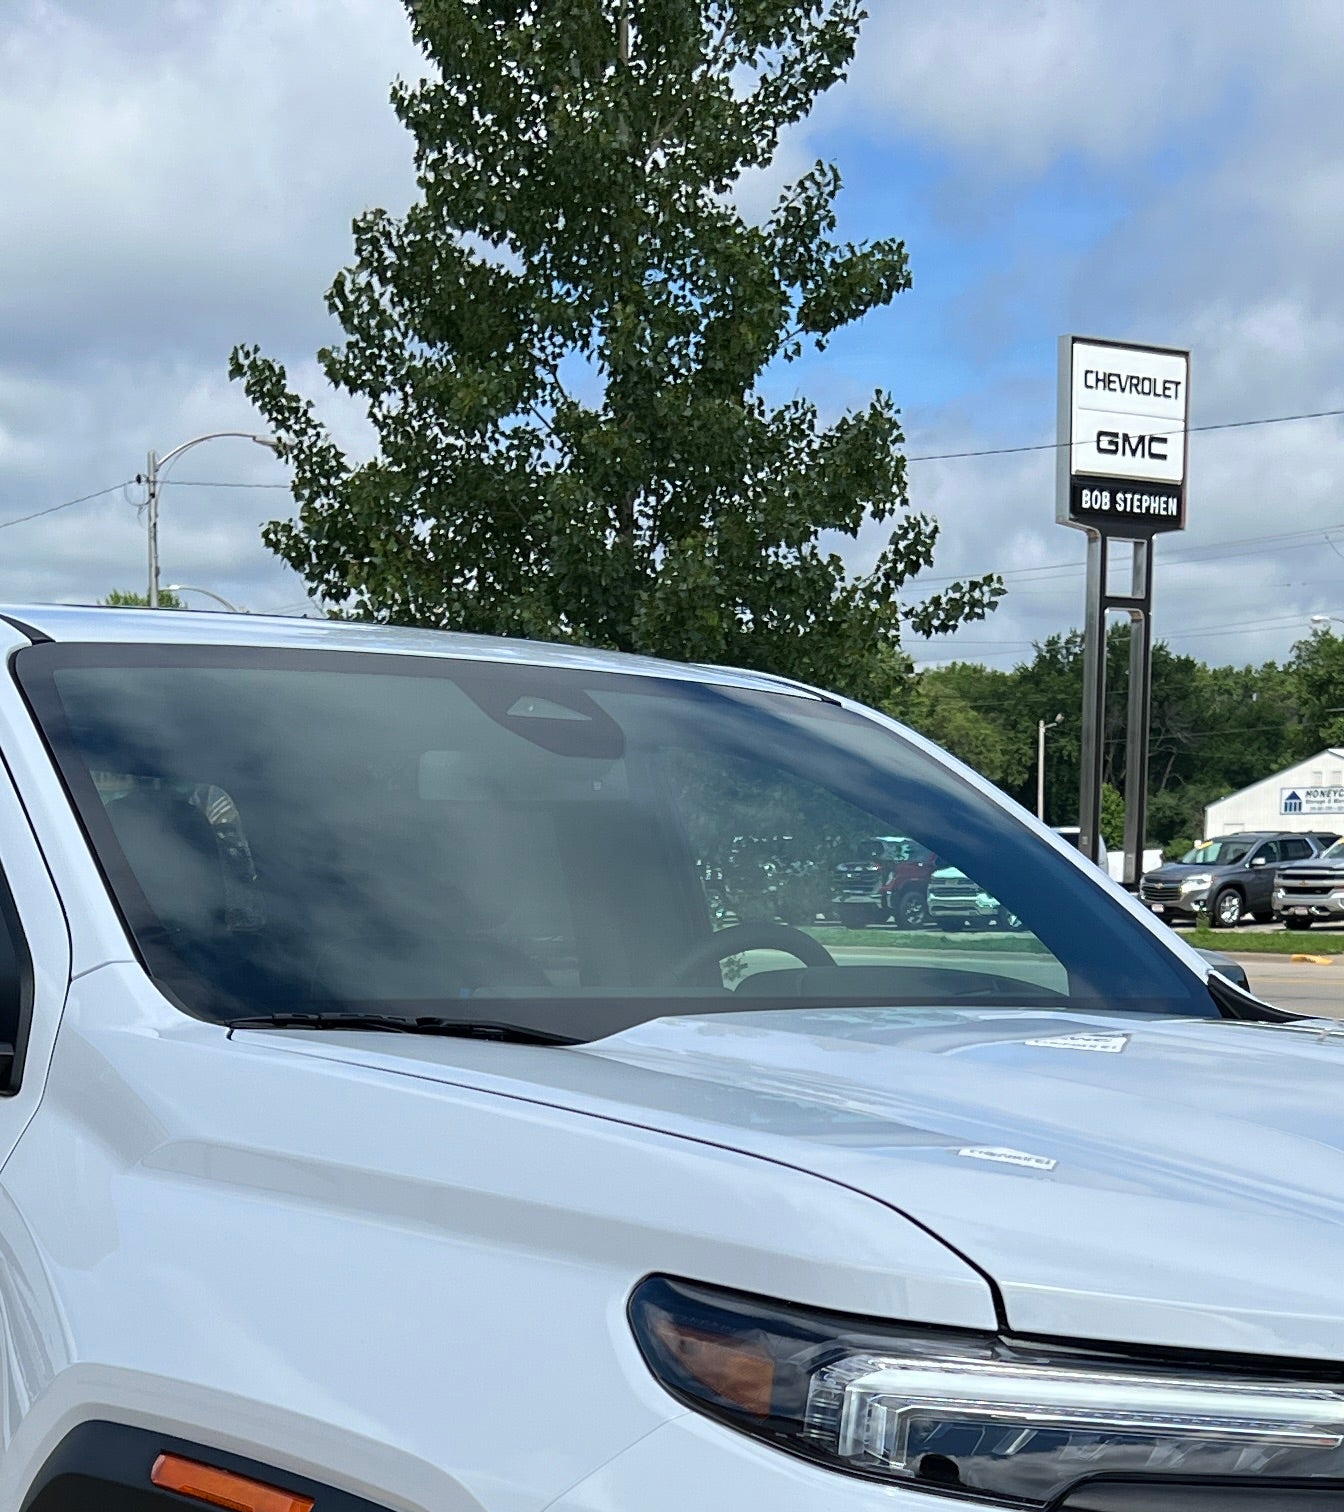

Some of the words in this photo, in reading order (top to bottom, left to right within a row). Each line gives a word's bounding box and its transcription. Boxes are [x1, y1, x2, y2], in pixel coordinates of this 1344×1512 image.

[1084, 369, 1181, 400] CHEVROLET
[1096, 430, 1168, 461] GMC
[1081, 489, 1110, 510] BOB
[1116, 492, 1177, 516] STEPHEN
